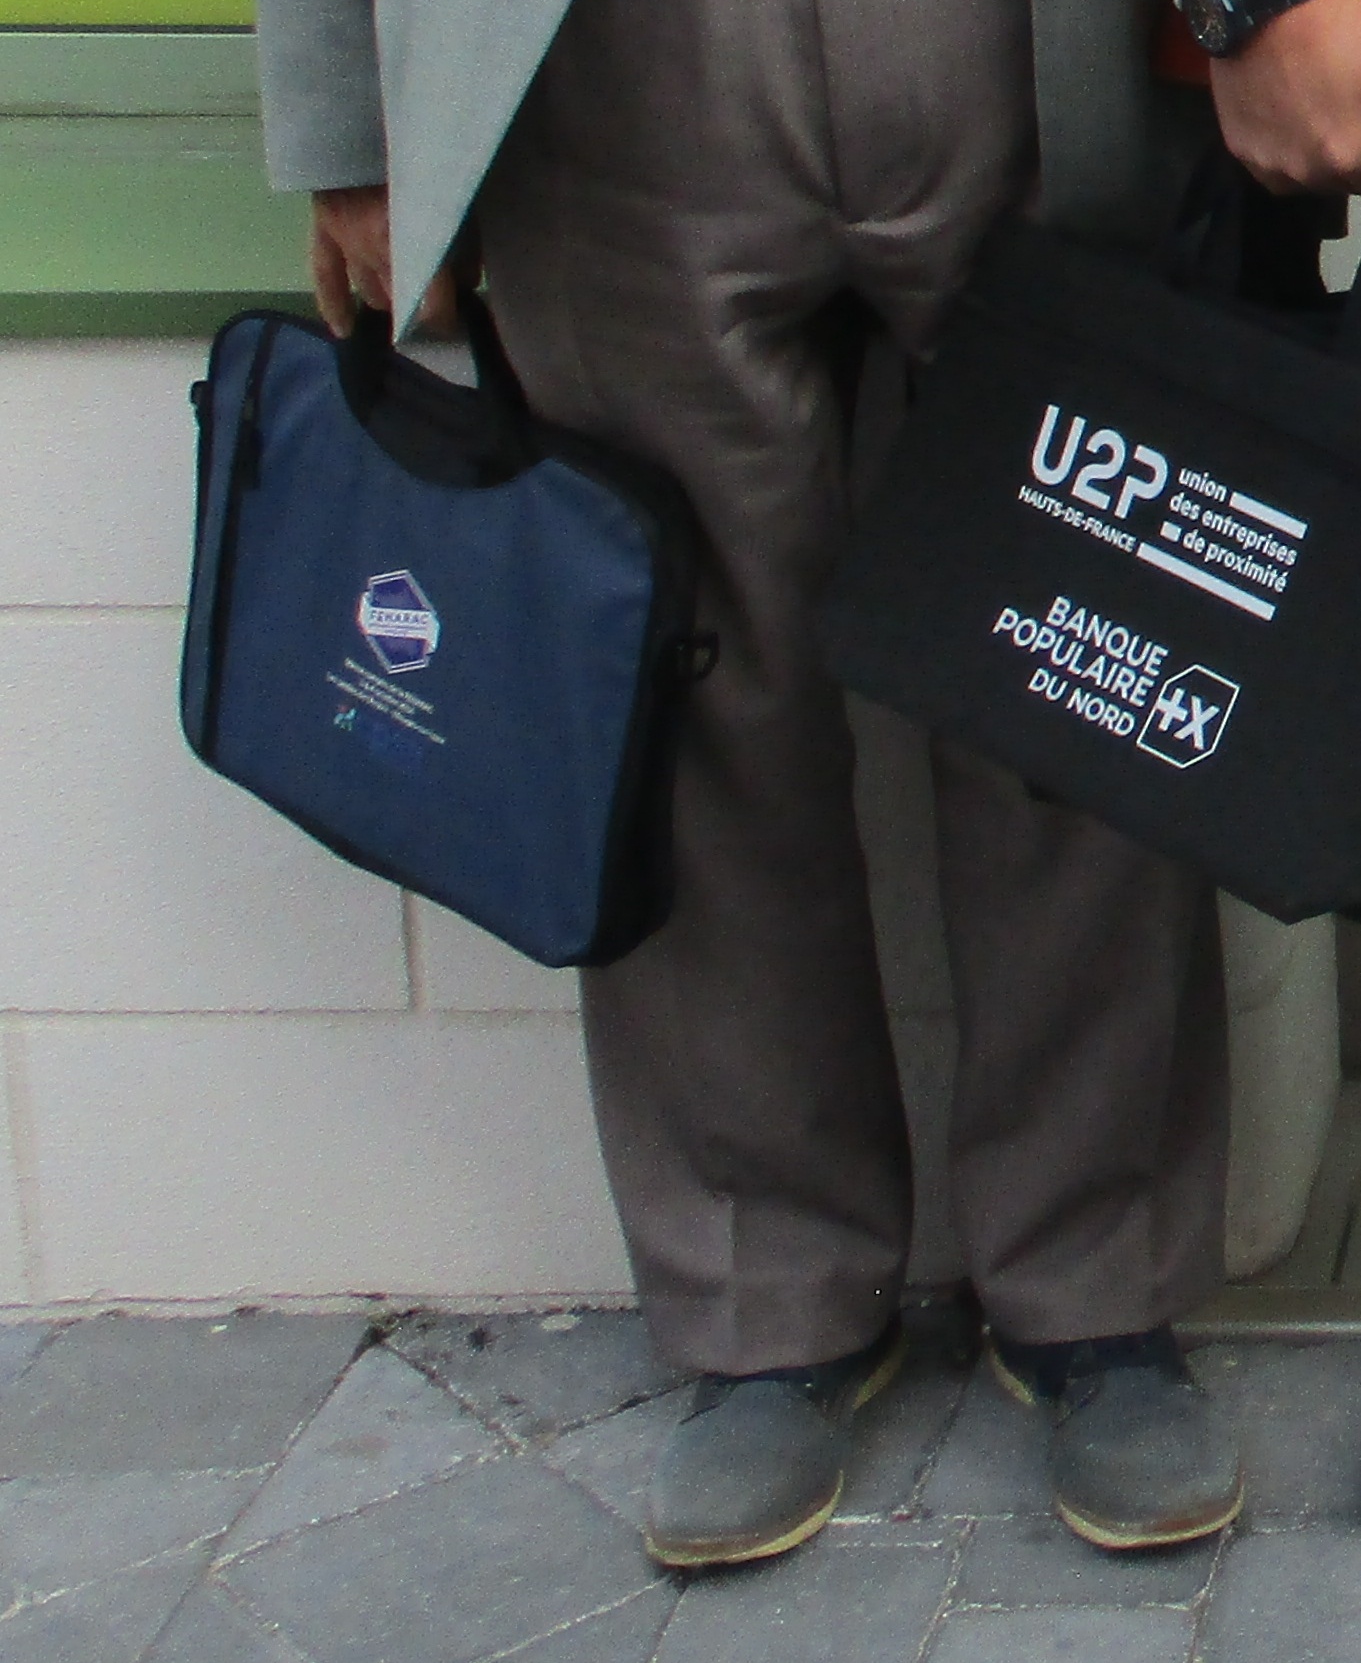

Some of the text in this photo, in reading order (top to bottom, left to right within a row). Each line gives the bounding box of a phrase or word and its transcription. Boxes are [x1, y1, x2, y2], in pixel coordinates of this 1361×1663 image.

[1030, 404, 1168, 520] U2P
[1178, 466, 1228, 503] union
[1018, 485, 1137, 554] HAUTS-DE-FRANCE
[1169, 491, 1298, 567] des entreprises
[1182, 527, 1290, 593] de proximité
[992, 607, 1155, 708] POPULAIRE
[1045, 595, 1169, 676] BANQUE
[1027, 667, 1136, 738] DU NORD
